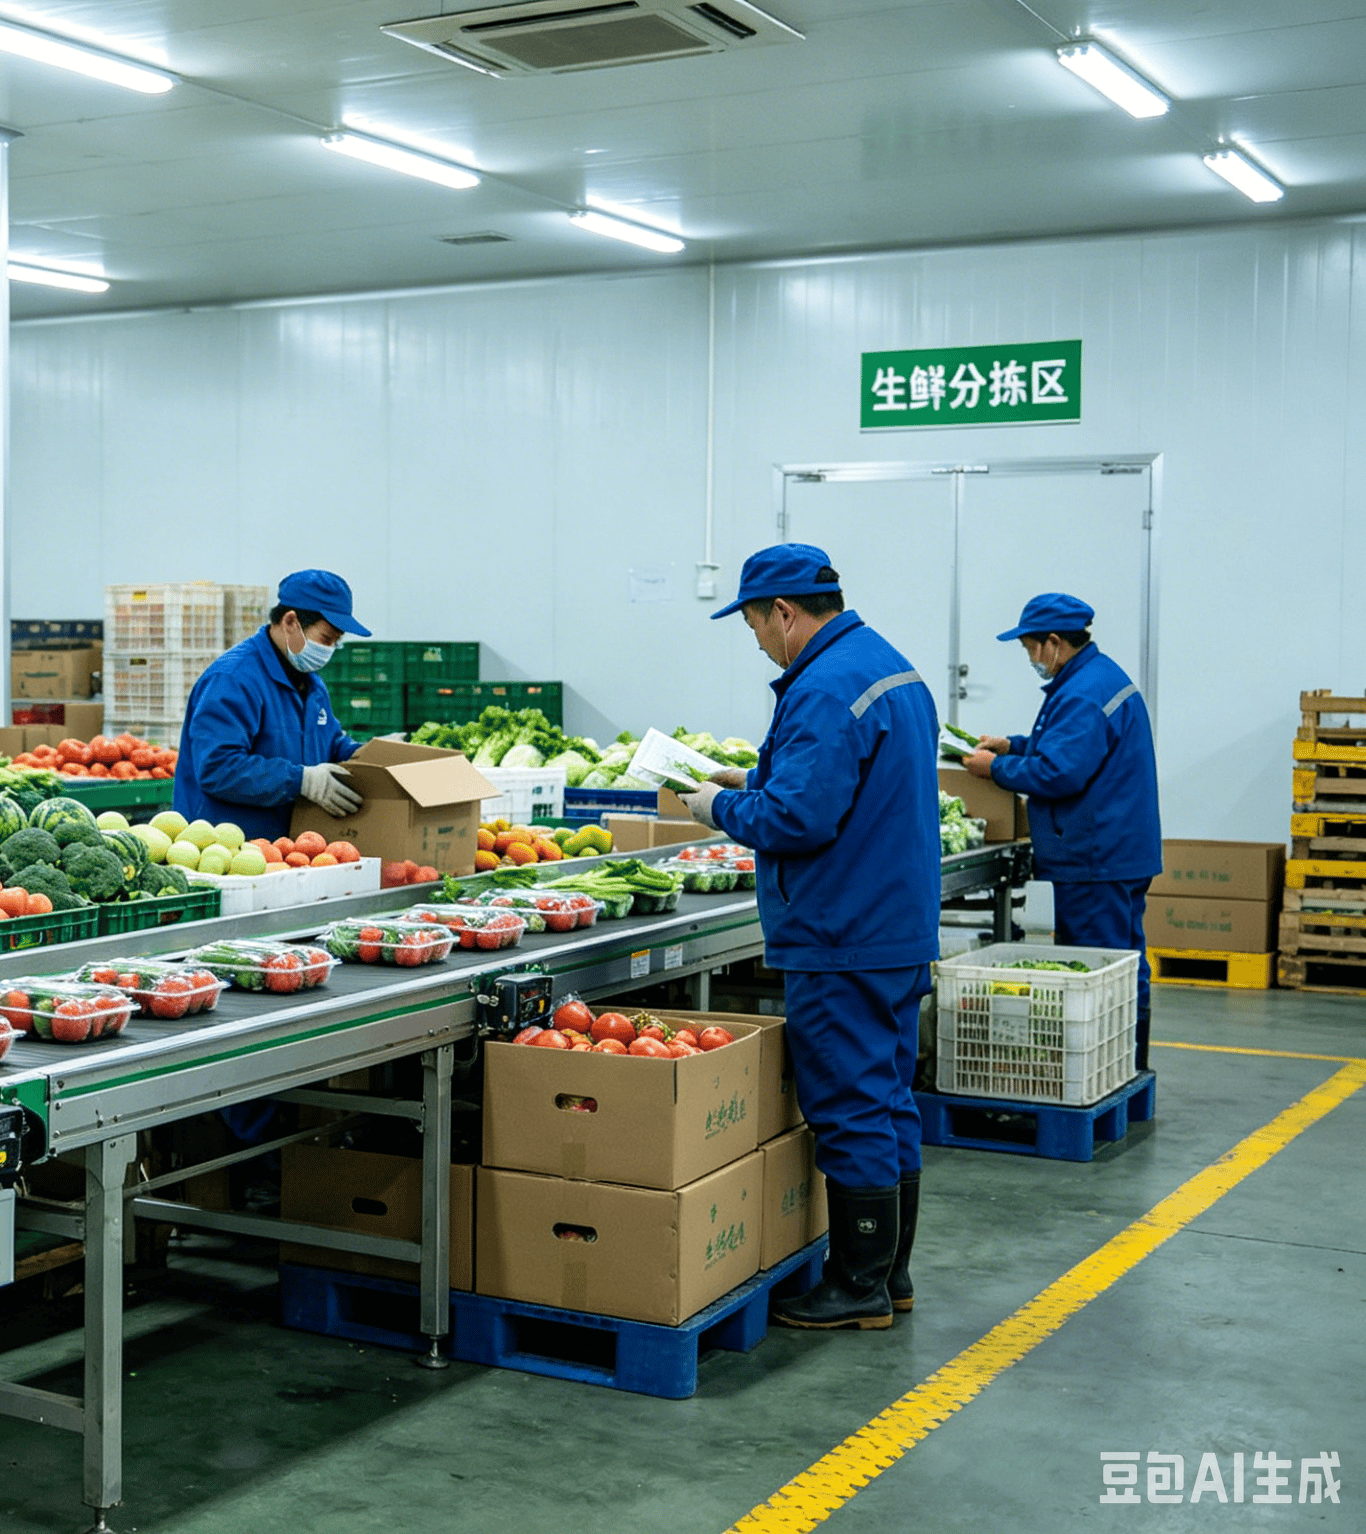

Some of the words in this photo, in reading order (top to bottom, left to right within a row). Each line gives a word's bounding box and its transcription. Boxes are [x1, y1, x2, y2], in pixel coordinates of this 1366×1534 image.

[871, 359, 1069, 411] 生鲜分拣区
